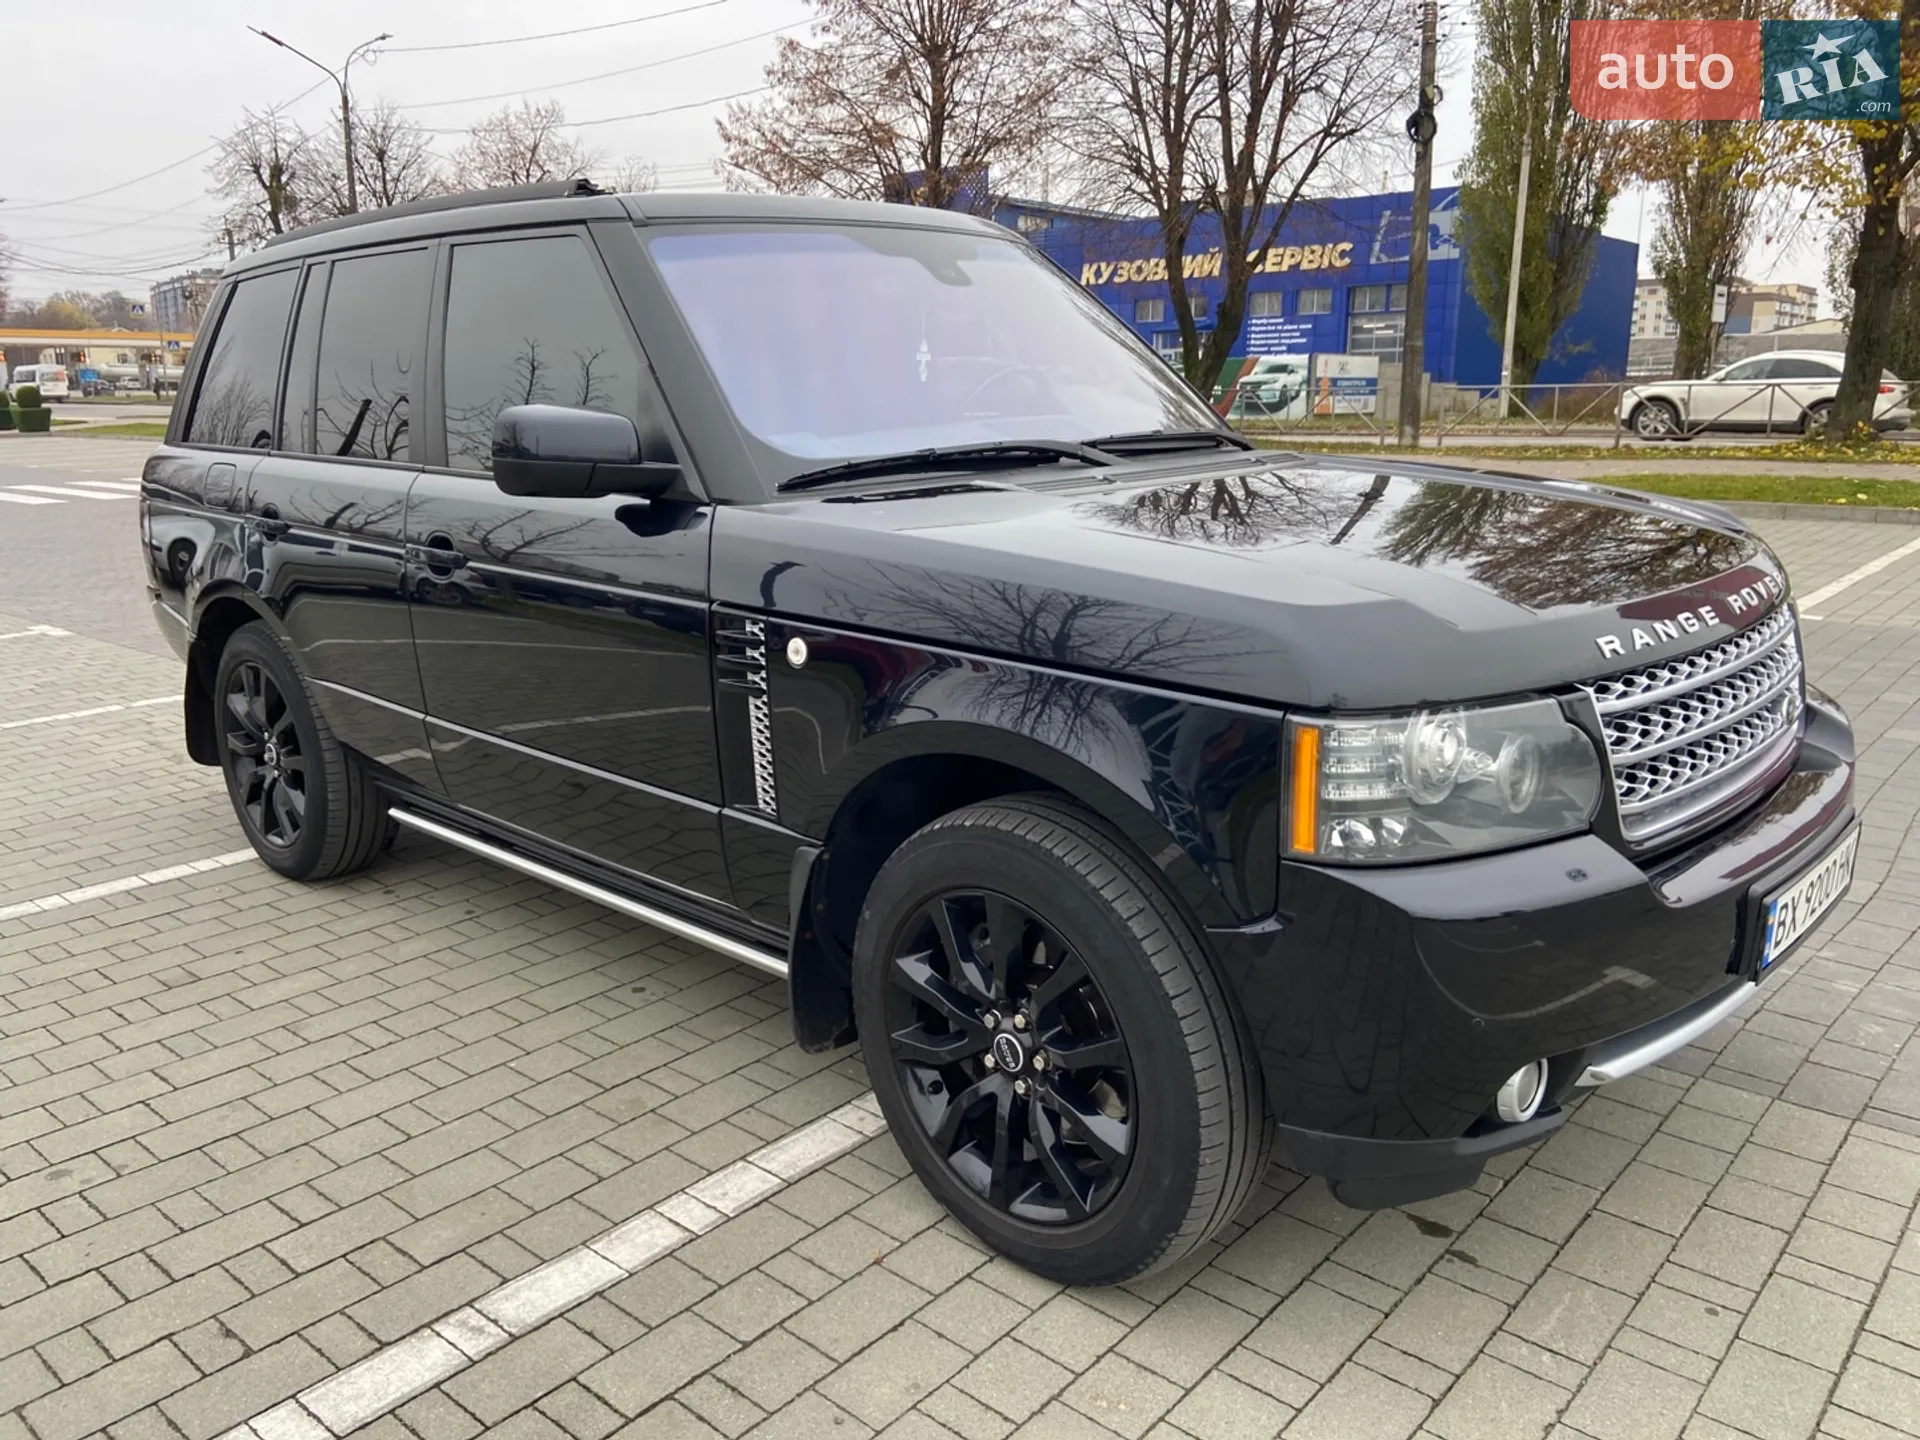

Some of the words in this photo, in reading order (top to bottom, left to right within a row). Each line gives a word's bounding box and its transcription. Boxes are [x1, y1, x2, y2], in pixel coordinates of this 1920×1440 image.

[1080, 247, 1223, 286] КУЗОВИЙ
[1595, 605, 1720, 659] RANGE
[1726, 571, 1785, 615] ROVER
[1773, 888, 1803, 951] BX
[1802, 857, 1838, 927] 9200
